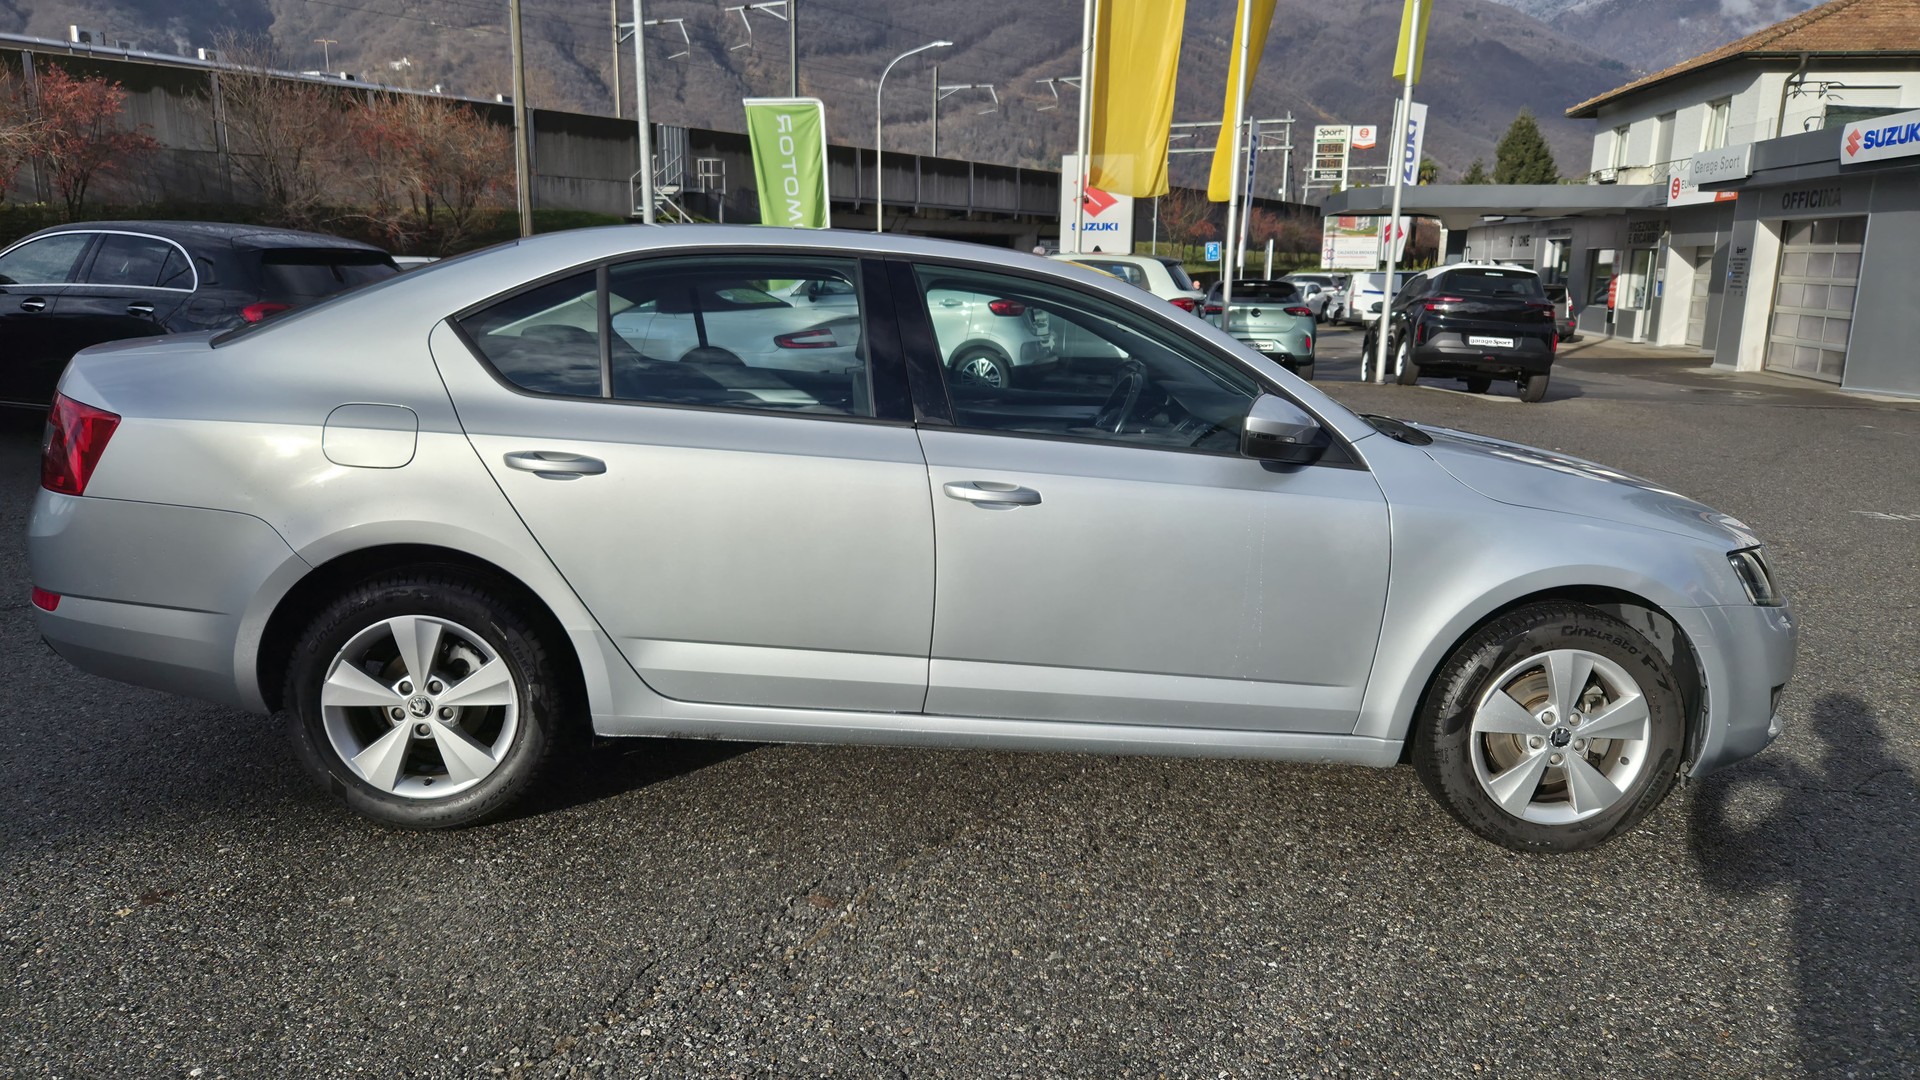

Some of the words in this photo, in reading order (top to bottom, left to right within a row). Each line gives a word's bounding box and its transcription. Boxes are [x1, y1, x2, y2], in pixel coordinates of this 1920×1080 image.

[1318, 127, 1345, 138] Sport
[1402, 120, 1418, 185] ZUKI
[1694, 160, 1719, 175] Garage
[1720, 156, 1741, 172] Sport
[1782, 187, 1841, 210] OFFICINA
[1561, 625, 1641, 655] Cinturato
